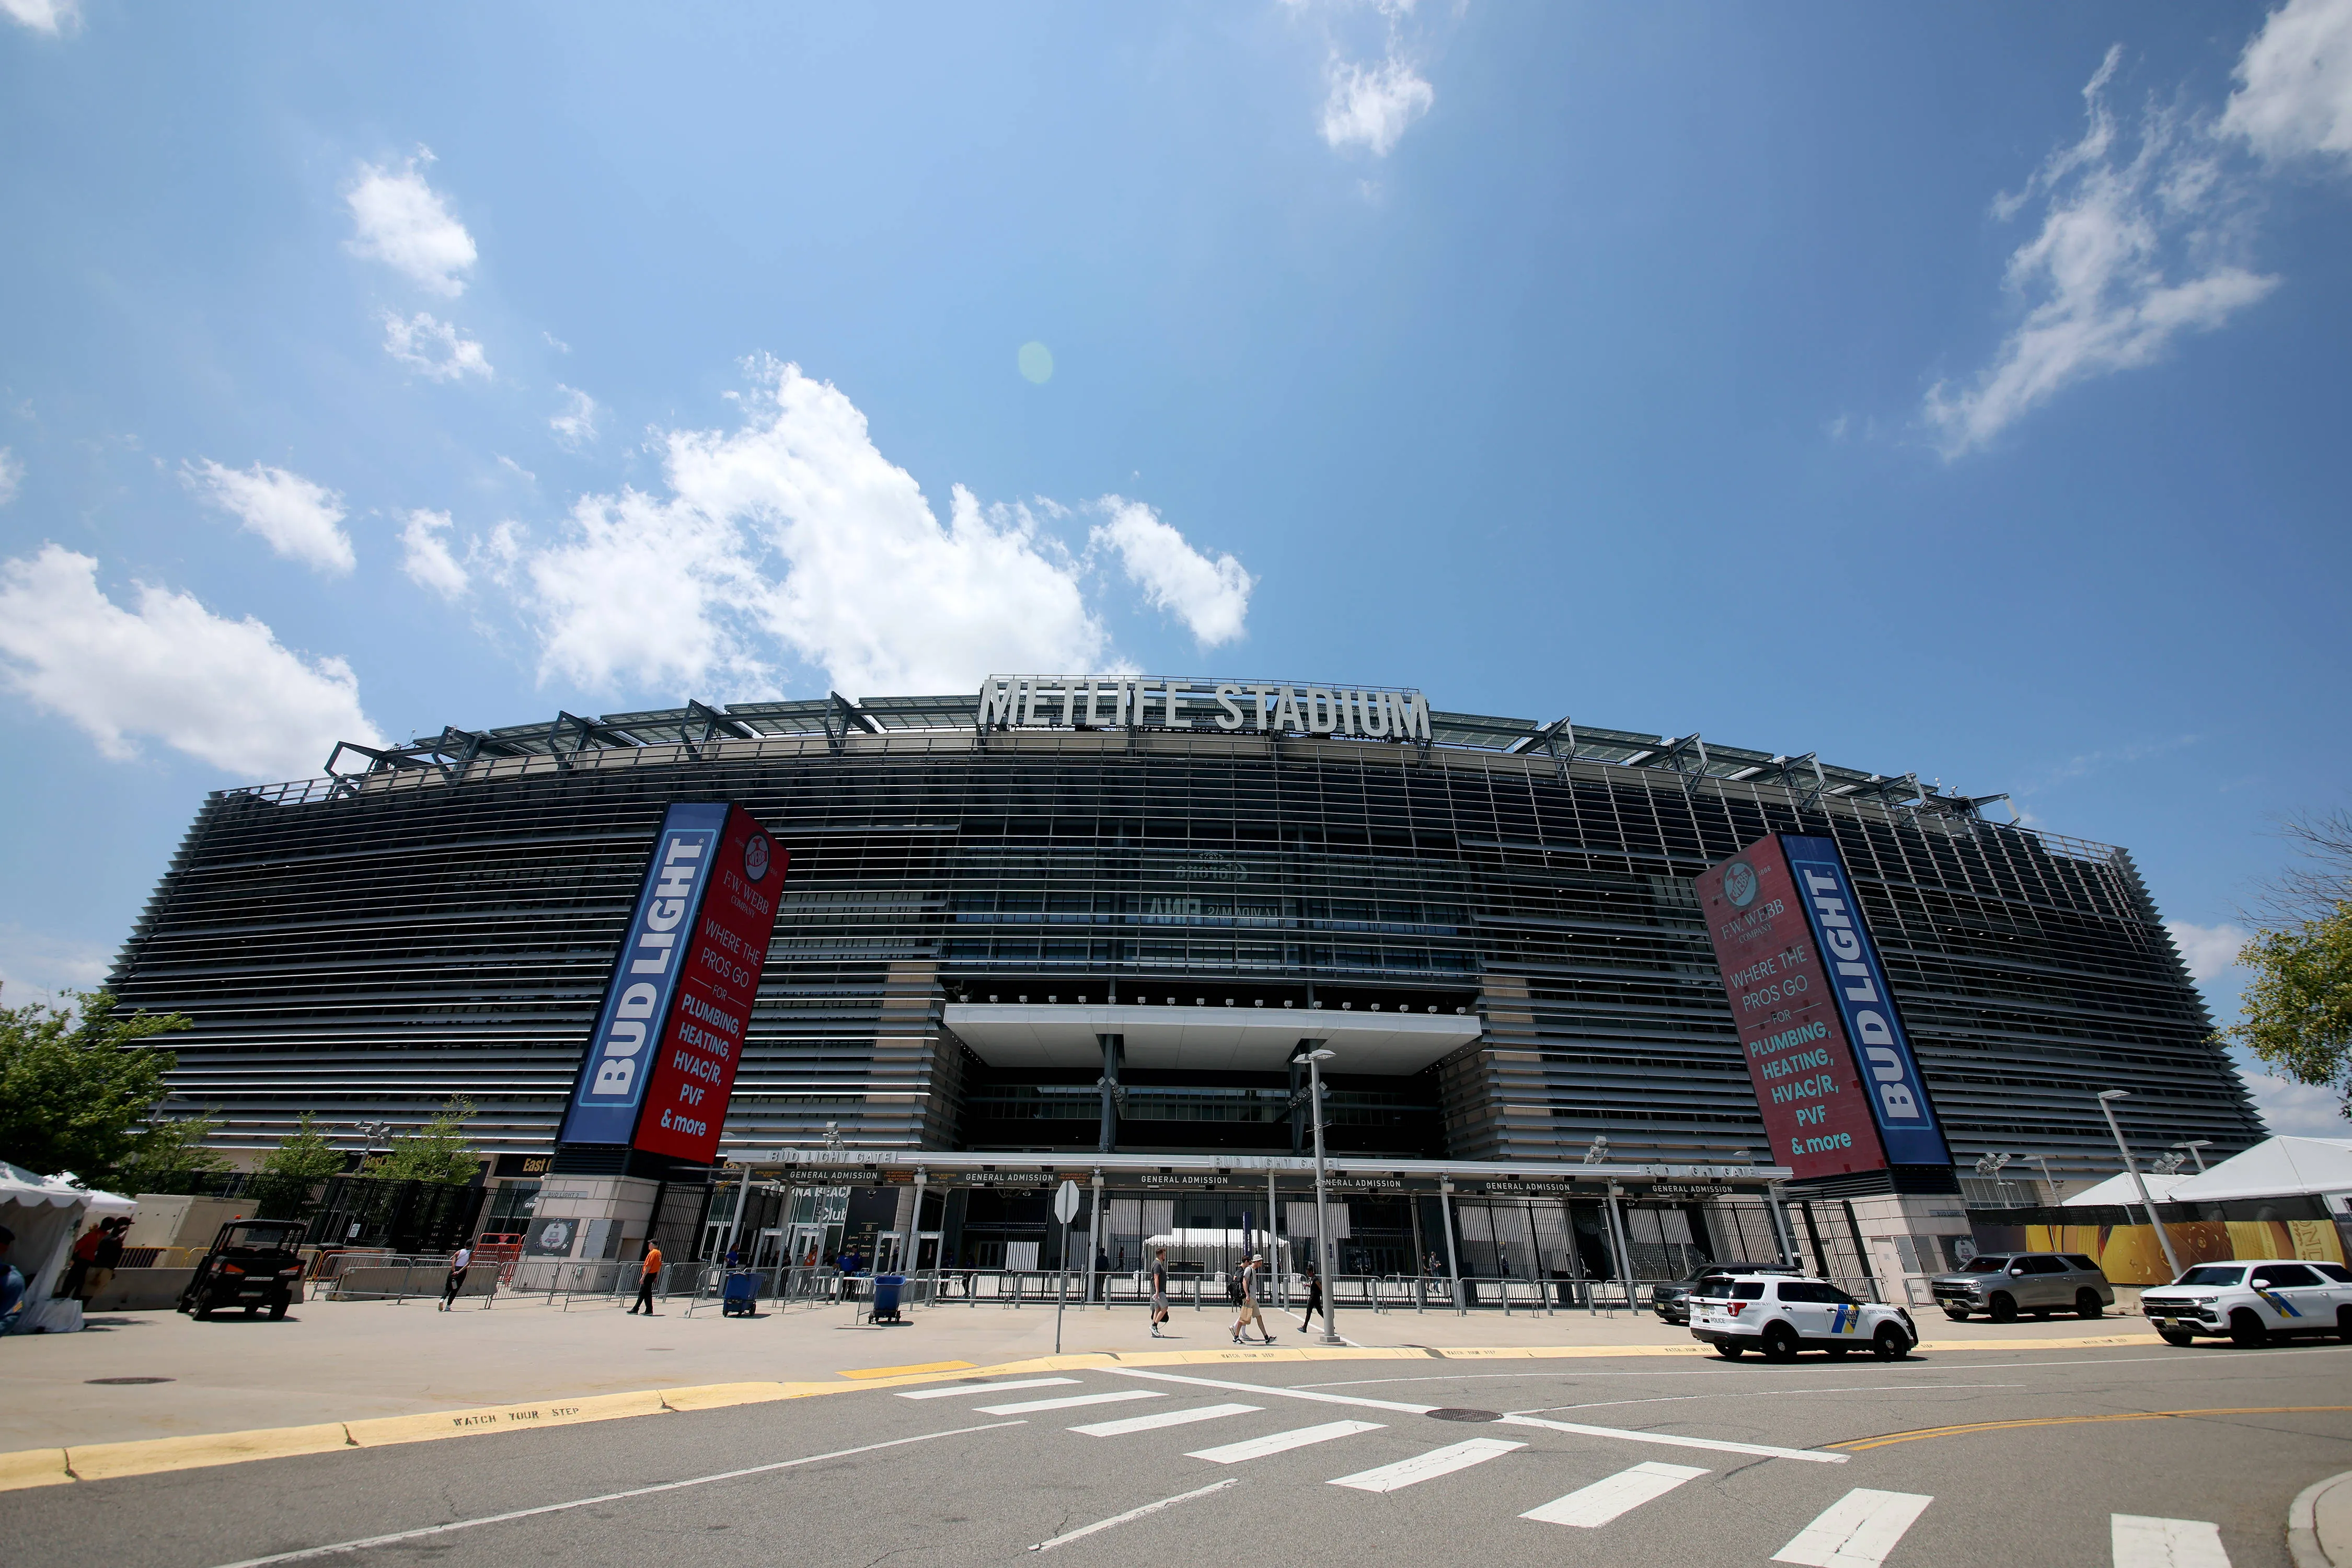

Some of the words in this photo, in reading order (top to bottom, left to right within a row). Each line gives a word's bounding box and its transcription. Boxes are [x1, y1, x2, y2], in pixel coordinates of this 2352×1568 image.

[978, 680, 1191, 728] METLIFE
[1215, 683, 1432, 740] STADIUM
[750, 850, 765, 866] WEBB
[1757, 866, 1771, 876] 1866
[723, 870, 742, 894] F.W.
[744, 883, 769, 915] WEBB
[1732, 871, 1749, 897] WEBB
[731, 895, 755, 918] COMPANY
[1721, 918, 1744, 940] F.W.
[1744, 898, 1784, 928] WEBB
[706, 918, 741, 958] WHERE
[743, 945, 760, 967] THE
[1739, 921, 1772, 943] COMPANY
[1803, 869, 1878, 1004] LIGHT
[592, 983, 657, 1095] BUD
[630, 838, 702, 974] LIGHT
[701, 947, 730, 979] PROS
[732, 966, 749, 988] GO
[1730, 960, 1777, 989] WHERE
[1778, 945, 1808, 971] THE
[712, 985, 727, 1001] FOR
[1742, 985, 1780, 1012] PROS
[1782, 975, 1808, 1000] GO
[681, 994, 740, 1039] PLUMBING,
[1771, 1009, 1791, 1024] FOR
[678, 1022, 730, 1061] HEATING,
[1749, 1021, 1832, 1058] PLUMBING,
[672, 1050, 721, 1087] HVAC/R,
[1761, 1049, 1834, 1080] HEATING,
[1856, 1009, 1920, 1119] BUD
[679, 1083, 705, 1106] PVF
[1771, 1074, 1840, 1105] HVAC/R,
[661, 1108, 672, 1129] &
[675, 1112, 707, 1137] more
[1796, 1104, 1827, 1127] PVF
[769, 1151, 799, 1162] BUD
[806, 1151, 849, 1163] LIGHT
[856, 1151, 892, 1163] GATE
[1792, 1137, 1804, 1155] &
[1806, 1132, 1852, 1154] more
[523, 1158, 546, 1171] East
[1214, 1157, 1242, 1168] BUD
[1251, 1158, 1292, 1169] LIGHT
[1299, 1158, 1334, 1169] GAE
[1645, 1166, 1670, 1176] BUD
[1679, 1166, 1715, 1177] LIGHT
[1722, 1166, 1756, 1178] GATE
[1325, 1178, 1353, 1187] NERAL
[453, 1414, 497, 1426] WATCH
[509, 1410, 539, 1421] YOUR
[551, 1407, 580, 1417] STEP
